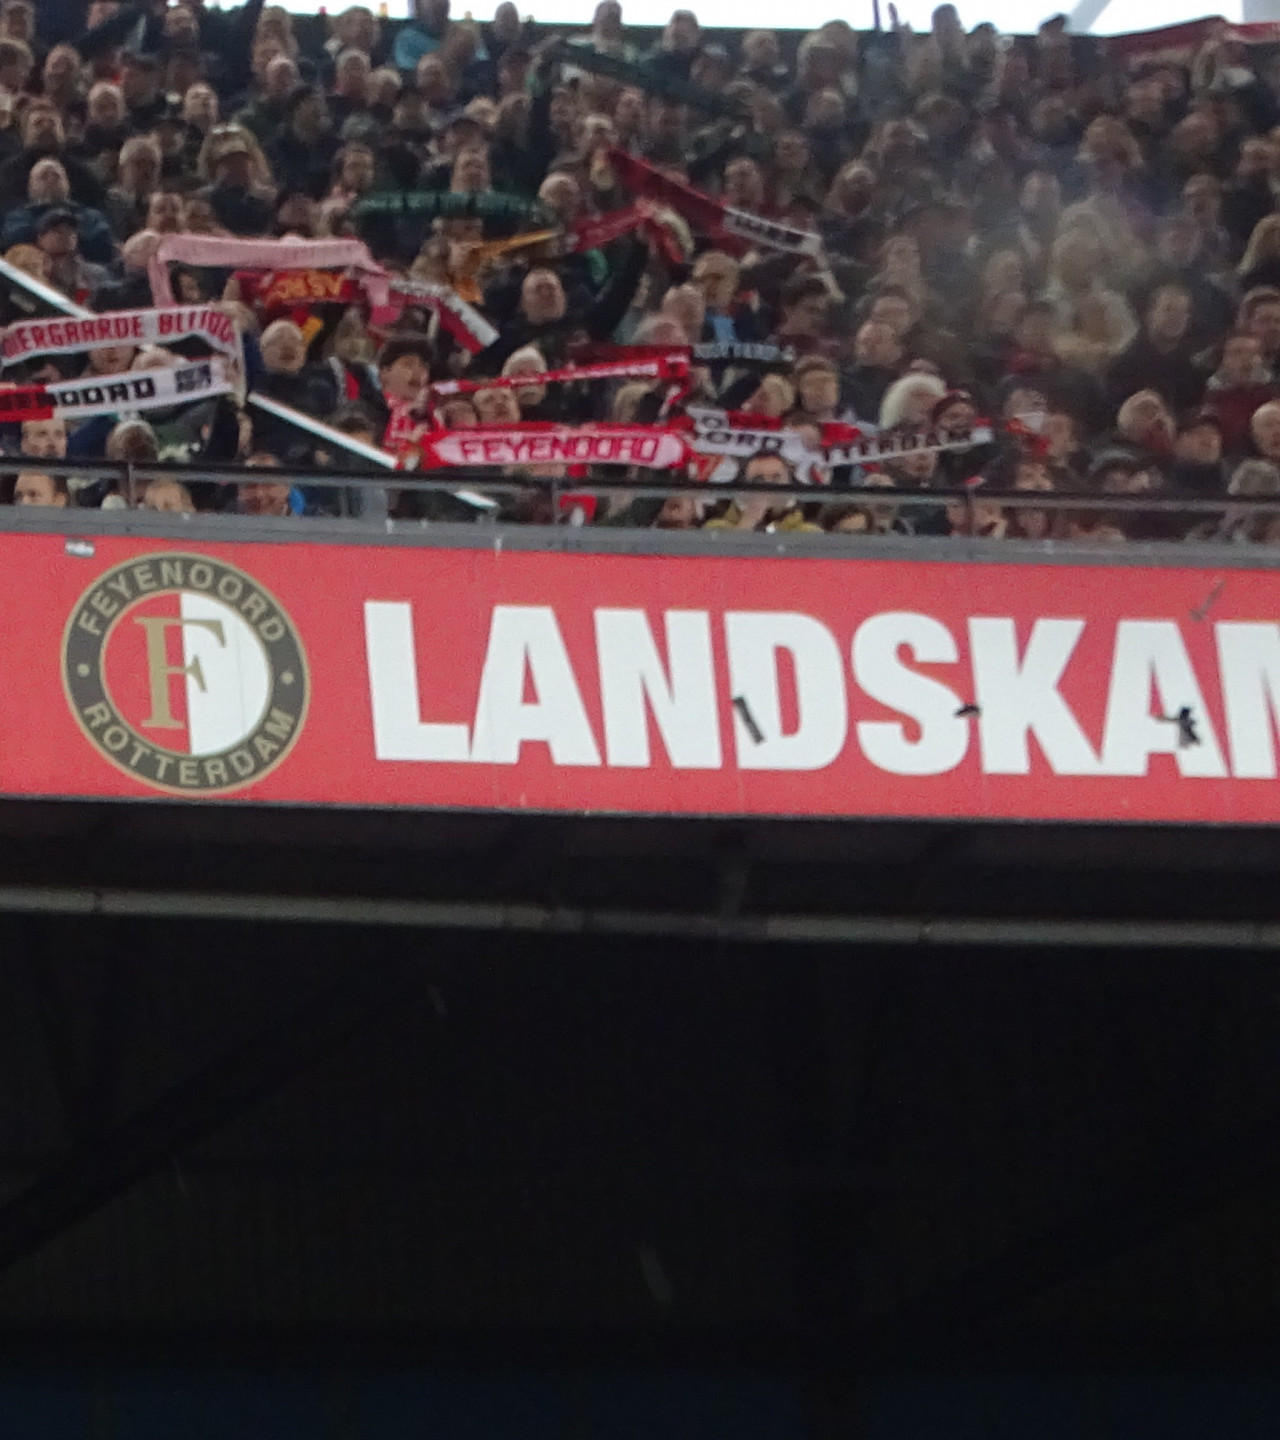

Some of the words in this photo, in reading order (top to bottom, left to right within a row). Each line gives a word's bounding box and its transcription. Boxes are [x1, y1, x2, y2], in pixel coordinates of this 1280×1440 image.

[458, 436, 662, 464] FEYENOORD
[78, 559, 285, 642] FEYENOORD
[84, 702, 295, 787] ROTTERDAM
